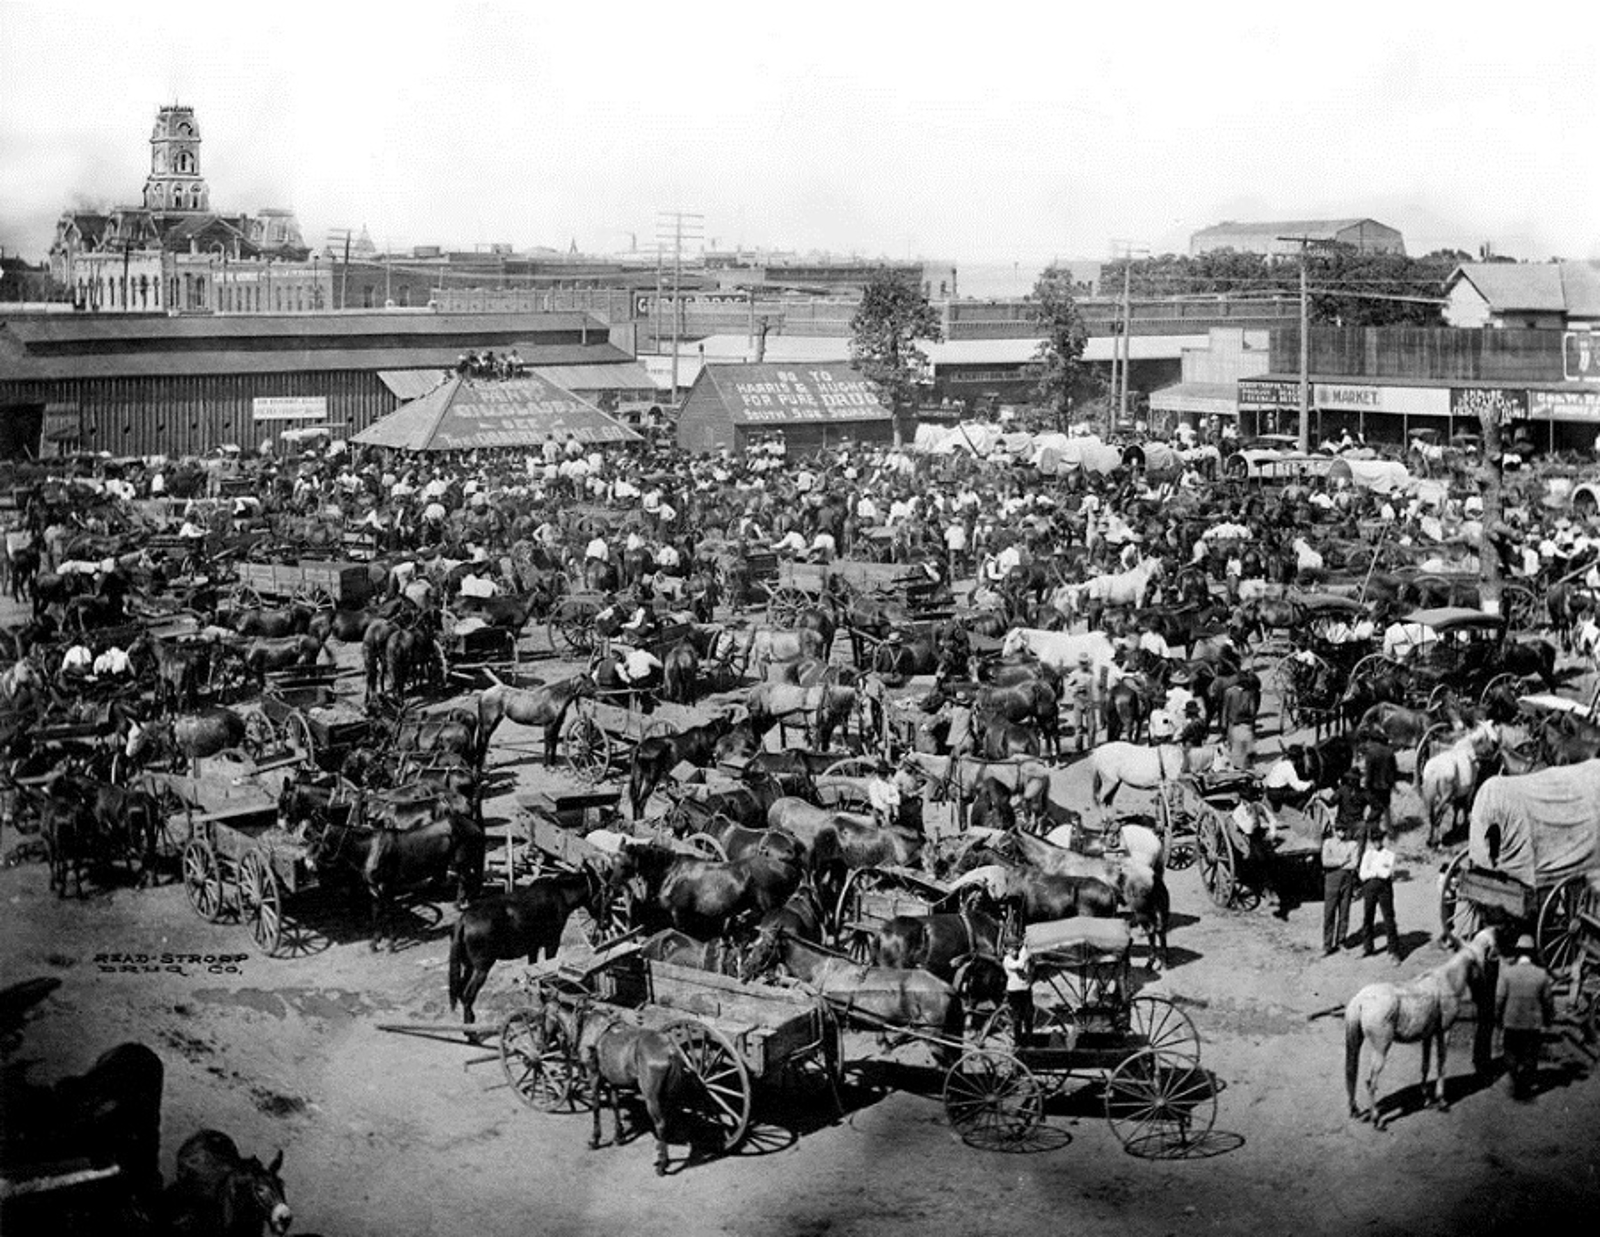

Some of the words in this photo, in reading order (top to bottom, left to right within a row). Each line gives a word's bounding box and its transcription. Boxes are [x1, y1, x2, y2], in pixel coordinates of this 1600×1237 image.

[808, 370, 832, 382] TO
[741, 394, 773, 406] FOR
[778, 394, 819, 408] PURE
